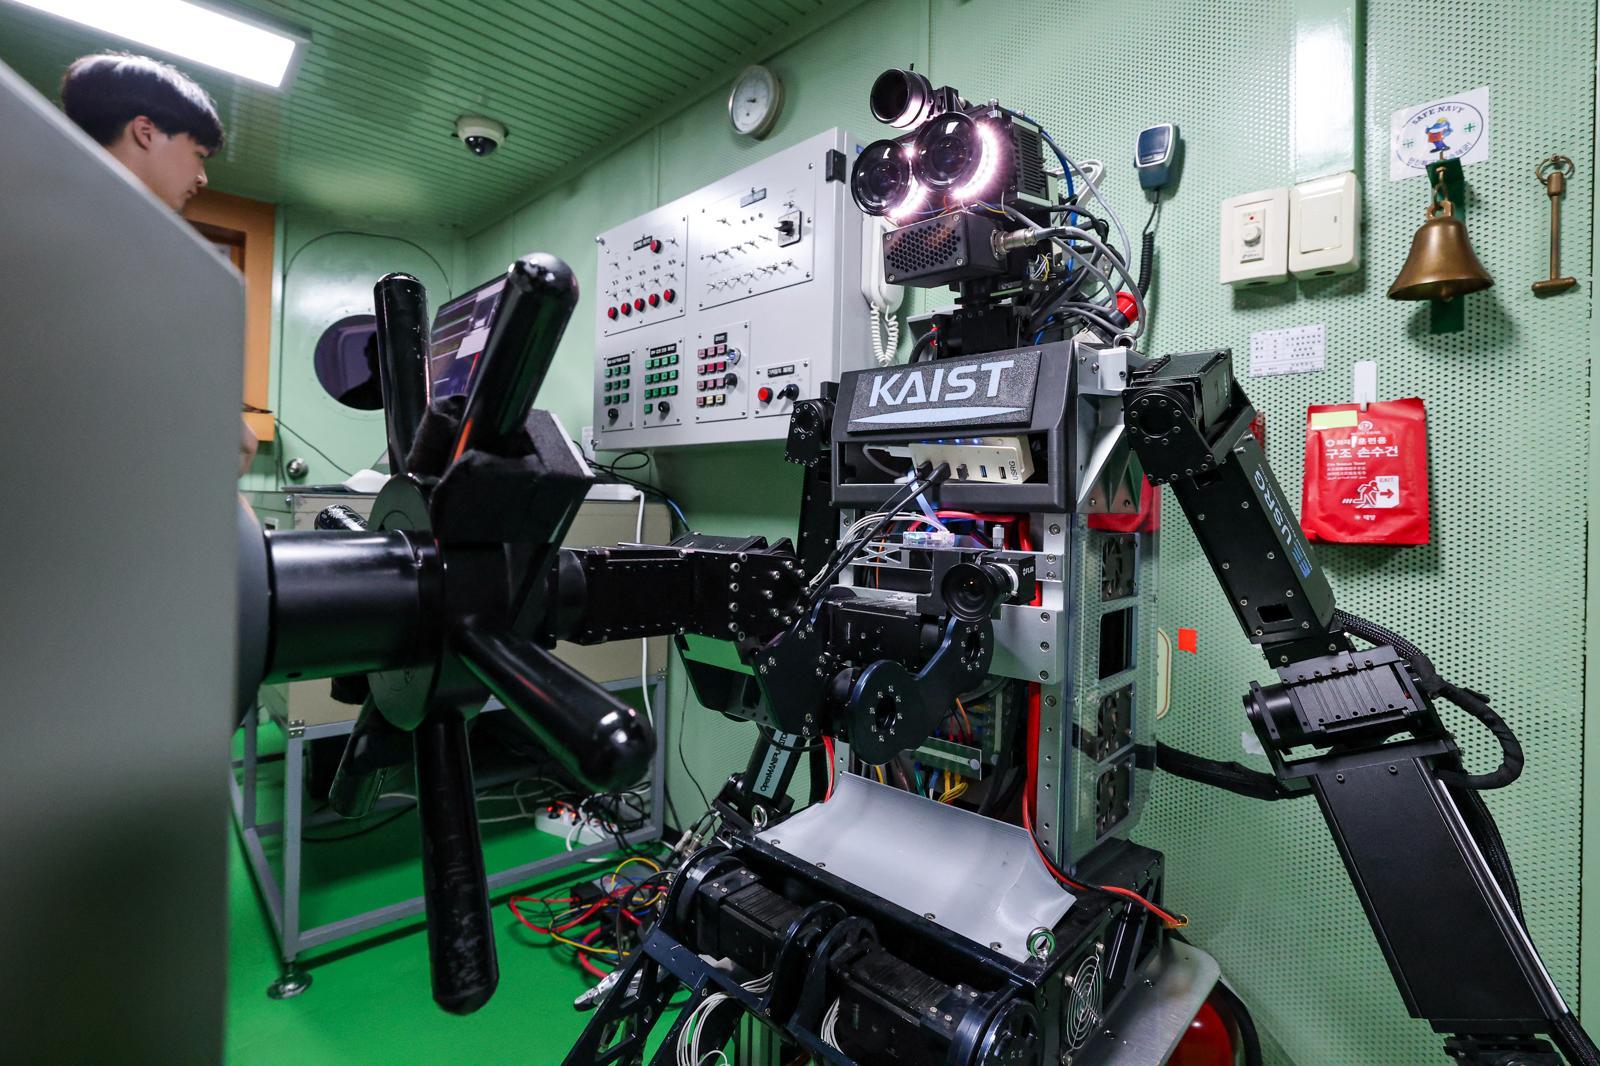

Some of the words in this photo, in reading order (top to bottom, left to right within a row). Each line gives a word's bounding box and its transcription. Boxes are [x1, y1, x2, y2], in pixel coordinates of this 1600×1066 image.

[1412, 109, 1435, 125] SAFE
[1438, 105, 1465, 114] NAVY
[869, 360, 1014, 407] KAIST
[1325, 448, 1352, 460] 구조
[1357, 445, 1399, 458] 손수건
[1254, 470, 1292, 545] USRG
